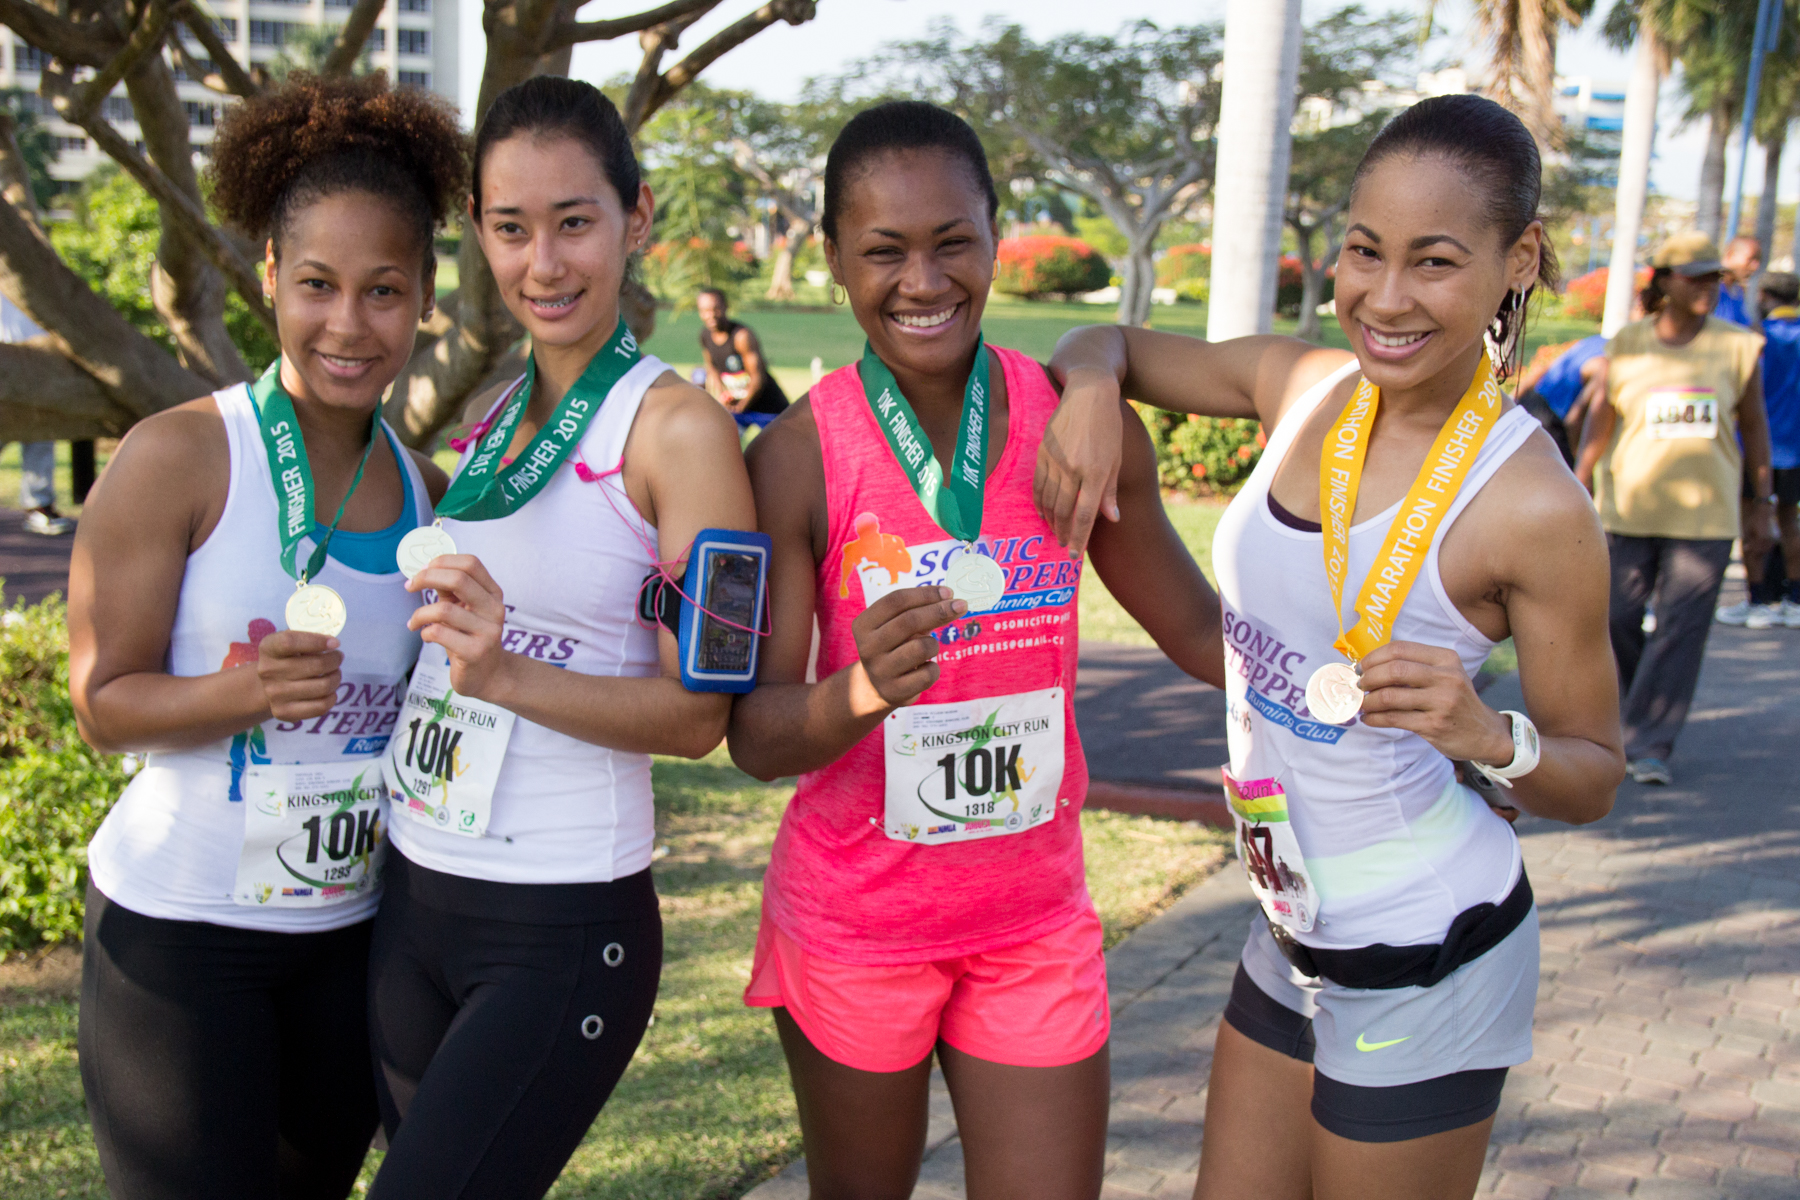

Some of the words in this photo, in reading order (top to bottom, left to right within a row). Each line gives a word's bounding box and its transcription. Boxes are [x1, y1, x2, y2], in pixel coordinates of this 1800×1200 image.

[971, 376, 985, 413] 2015
[1334, 376, 1373, 460] ARATHON
[270, 421, 297, 464] 2015
[508, 439, 562, 494] FINISHER
[553, 397, 589, 441] 2015
[877, 387, 897, 418] 10K
[889, 410, 925, 469] FINISHER
[965, 407, 984, 466] FINISHER
[1427, 409, 1483, 493] FINISHER
[963, 459, 980, 489] 10K
[281, 465, 306, 537] FINISHER
[1325, 467, 1349, 545] FINISHER
[1328, 546, 1345, 596] 2015
[1365, 497, 1438, 618] MARATHON
[1045, 588, 1073, 604] Club
[1224, 611, 1307, 676] SONIC
[335, 682, 403, 707] ONIC
[408, 692, 445, 715] KINGSTON
[446, 703, 468, 721] CITY
[469, 711, 497, 729] RUN
[1248, 690, 1295, 728] Running
[1295, 721, 1338, 741] Club
[405, 717, 463, 782] 10K
[922, 727, 990, 747] KINGSTON
[993, 723, 1021, 738] CITY
[1024, 718, 1050, 732] RUN
[287, 790, 355, 808] KINGSTON
[358, 786, 382, 799] CITY
[937, 743, 1022, 801] 10K
[1240, 785, 1270, 801] Run
[965, 801, 995, 816] 1318
[302, 808, 380, 863] 10K
